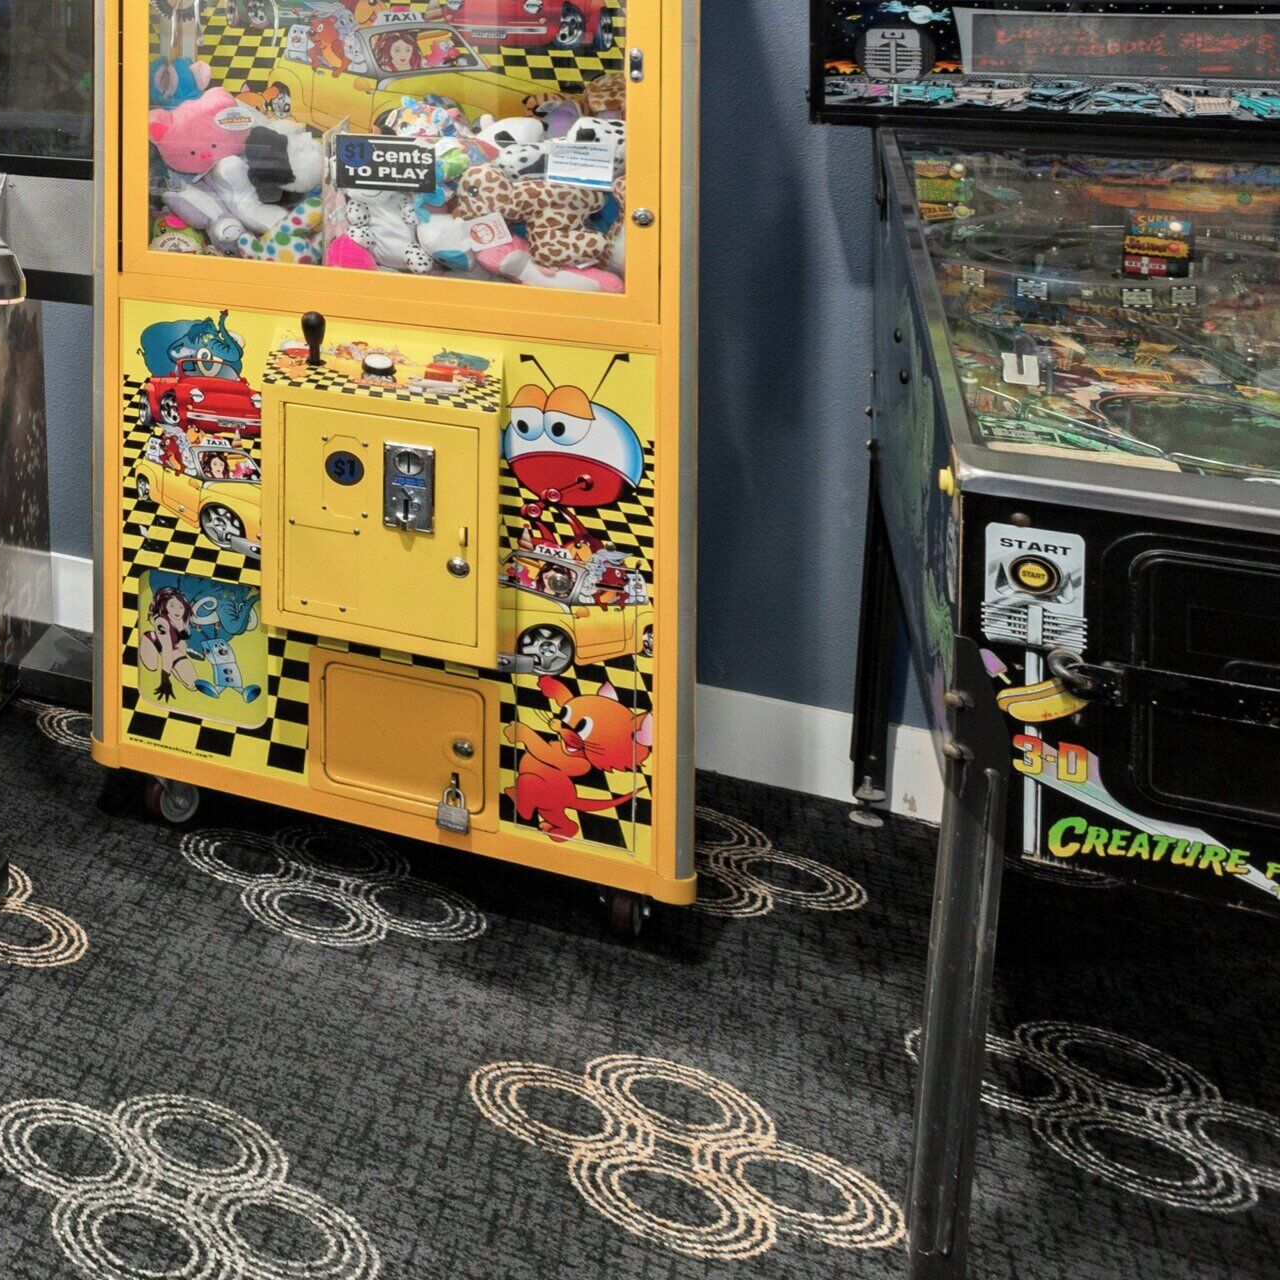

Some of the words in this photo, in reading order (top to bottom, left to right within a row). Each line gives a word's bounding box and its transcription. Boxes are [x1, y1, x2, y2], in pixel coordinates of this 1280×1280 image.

[382, 12, 418, 23] TAXI
[343, 140, 366, 162] $1
[371, 148, 433, 165] cents
[345, 165, 372, 177] TO
[378, 166, 429, 180] PLAY
[1137, 214, 1177, 229] SUPER
[206, 439, 228, 447] TAXI
[333, 456, 357, 477] $1
[536, 545, 570, 559] TAXI
[1000, 537, 1072, 556] START
[1021, 570, 1046, 581] START
[1012, 733, 1089, 785] 3-D
[1047, 816, 1251, 876] CREATURE
